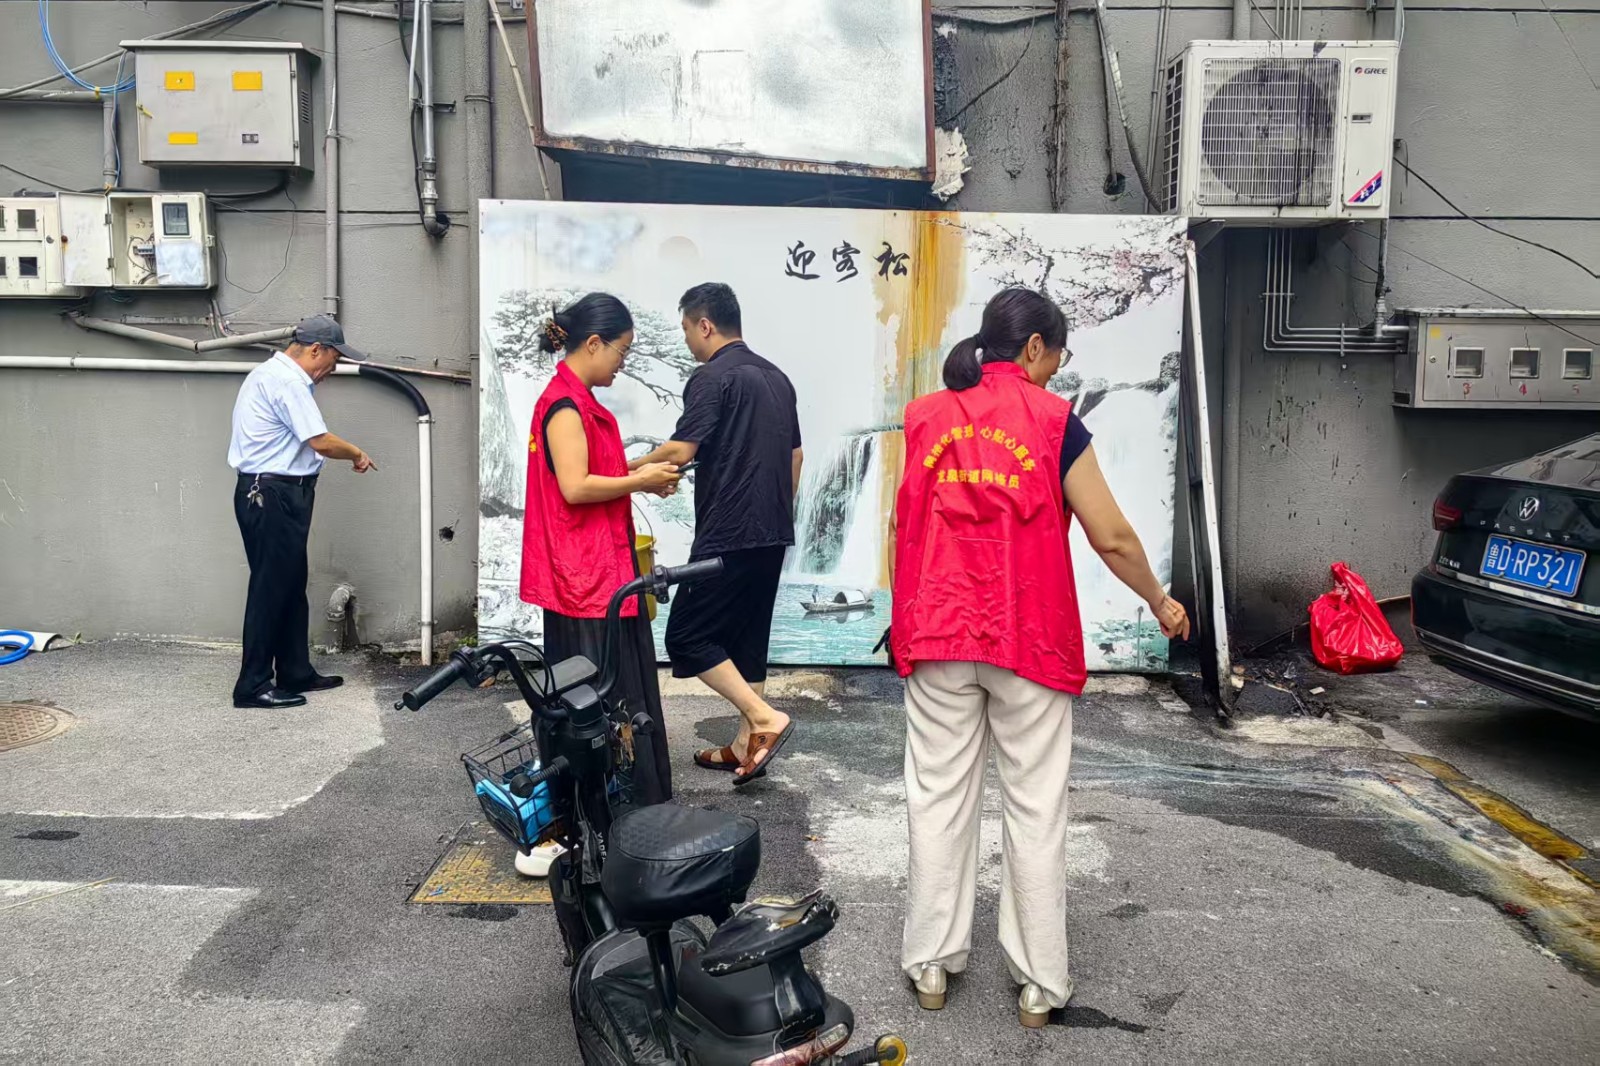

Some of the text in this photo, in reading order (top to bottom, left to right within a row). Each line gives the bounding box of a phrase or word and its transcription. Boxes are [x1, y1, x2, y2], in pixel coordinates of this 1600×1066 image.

[1364, 67, 1388, 75] GREE
[785, 240, 910, 283] 迎客松
[1519, 383, 1528, 396] 4
[1480, 520, 1571, 541] PASSAT
